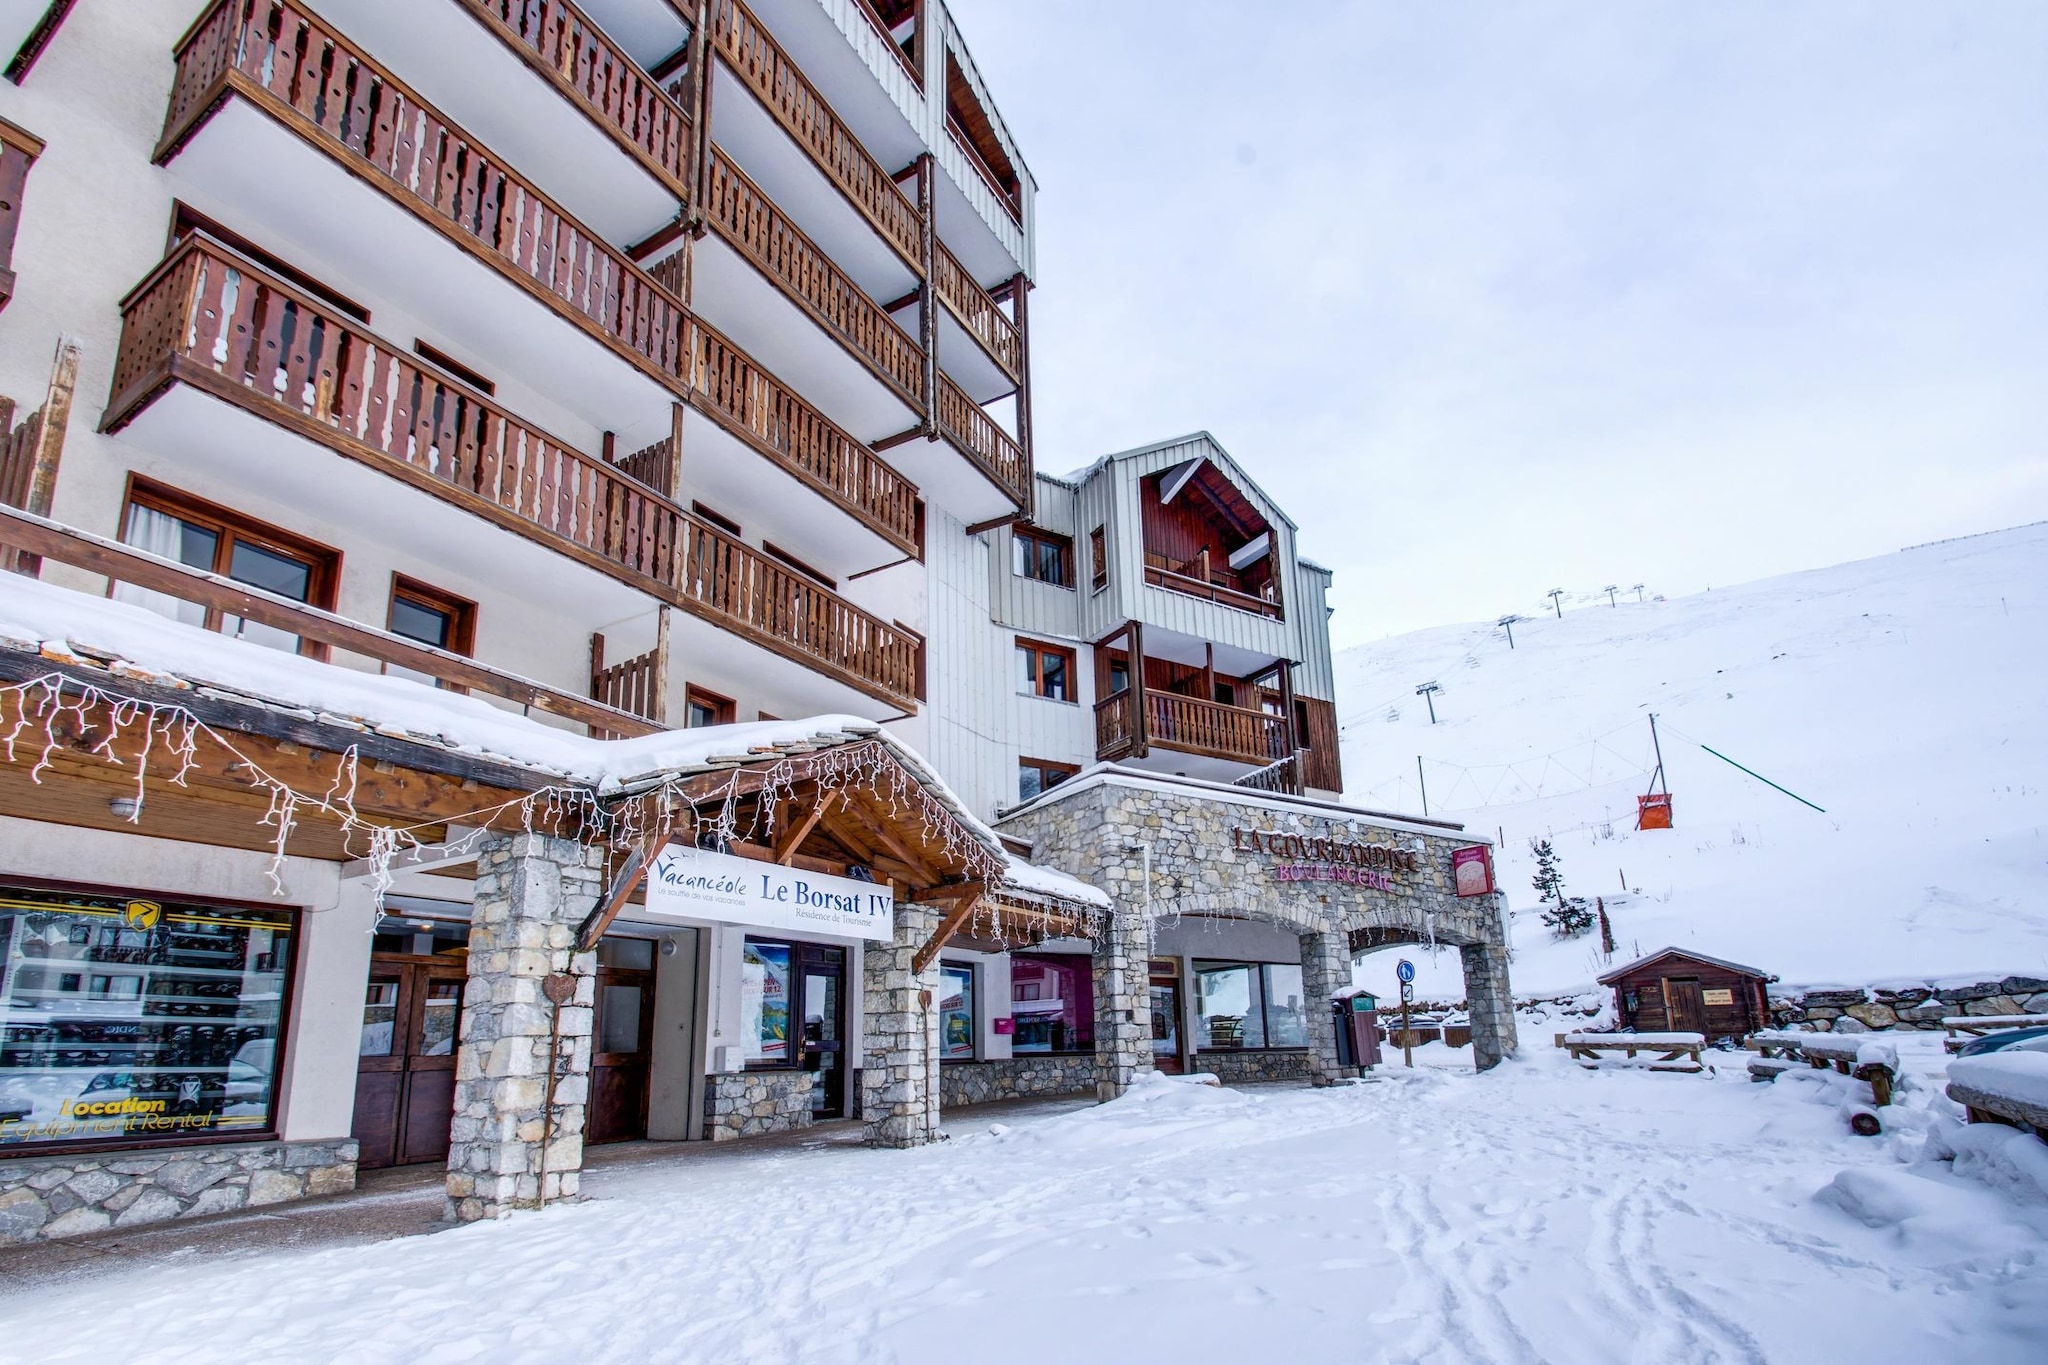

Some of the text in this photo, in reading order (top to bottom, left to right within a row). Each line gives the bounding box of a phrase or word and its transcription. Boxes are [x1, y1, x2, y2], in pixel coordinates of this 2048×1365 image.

[1233, 827, 1419, 872] LA GOURMANDISE
[656, 858, 747, 895] Vacancéole
[1279, 863, 1394, 893] BOULANGERIE
[691, 891, 701, 899] de
[714, 896, 746, 906] vacances
[760, 874, 892, 918] Le Borsat IV
[795, 907, 872, 927] Résidence de Tourisme
[60, 1095, 166, 1117] Location
[0, 1110, 213, 1140] Equipment Rental
